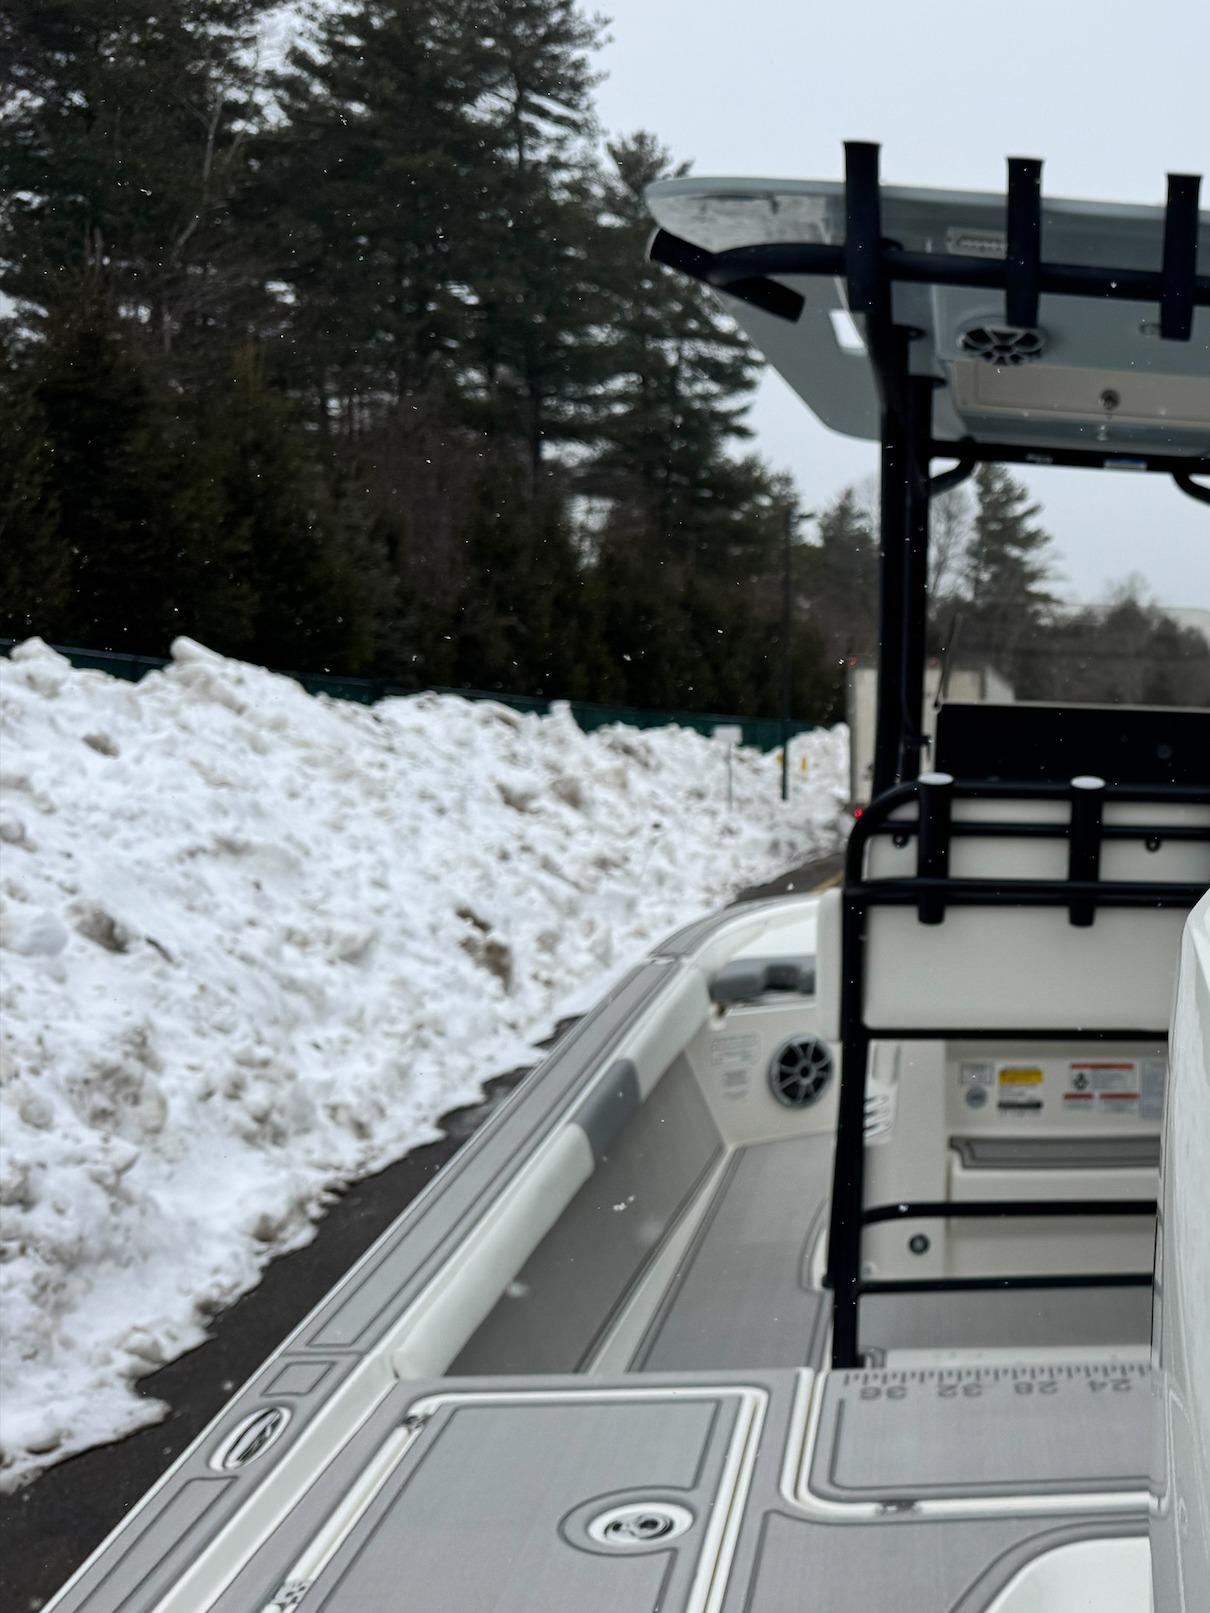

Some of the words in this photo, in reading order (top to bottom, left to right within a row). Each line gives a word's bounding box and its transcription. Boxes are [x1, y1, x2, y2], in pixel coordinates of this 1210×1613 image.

[860, 1385, 908, 1400] 36
[937, 1383, 983, 1398] 32
[1014, 1381, 1058, 1395] 28
[1088, 1378, 1132, 1393] 24
